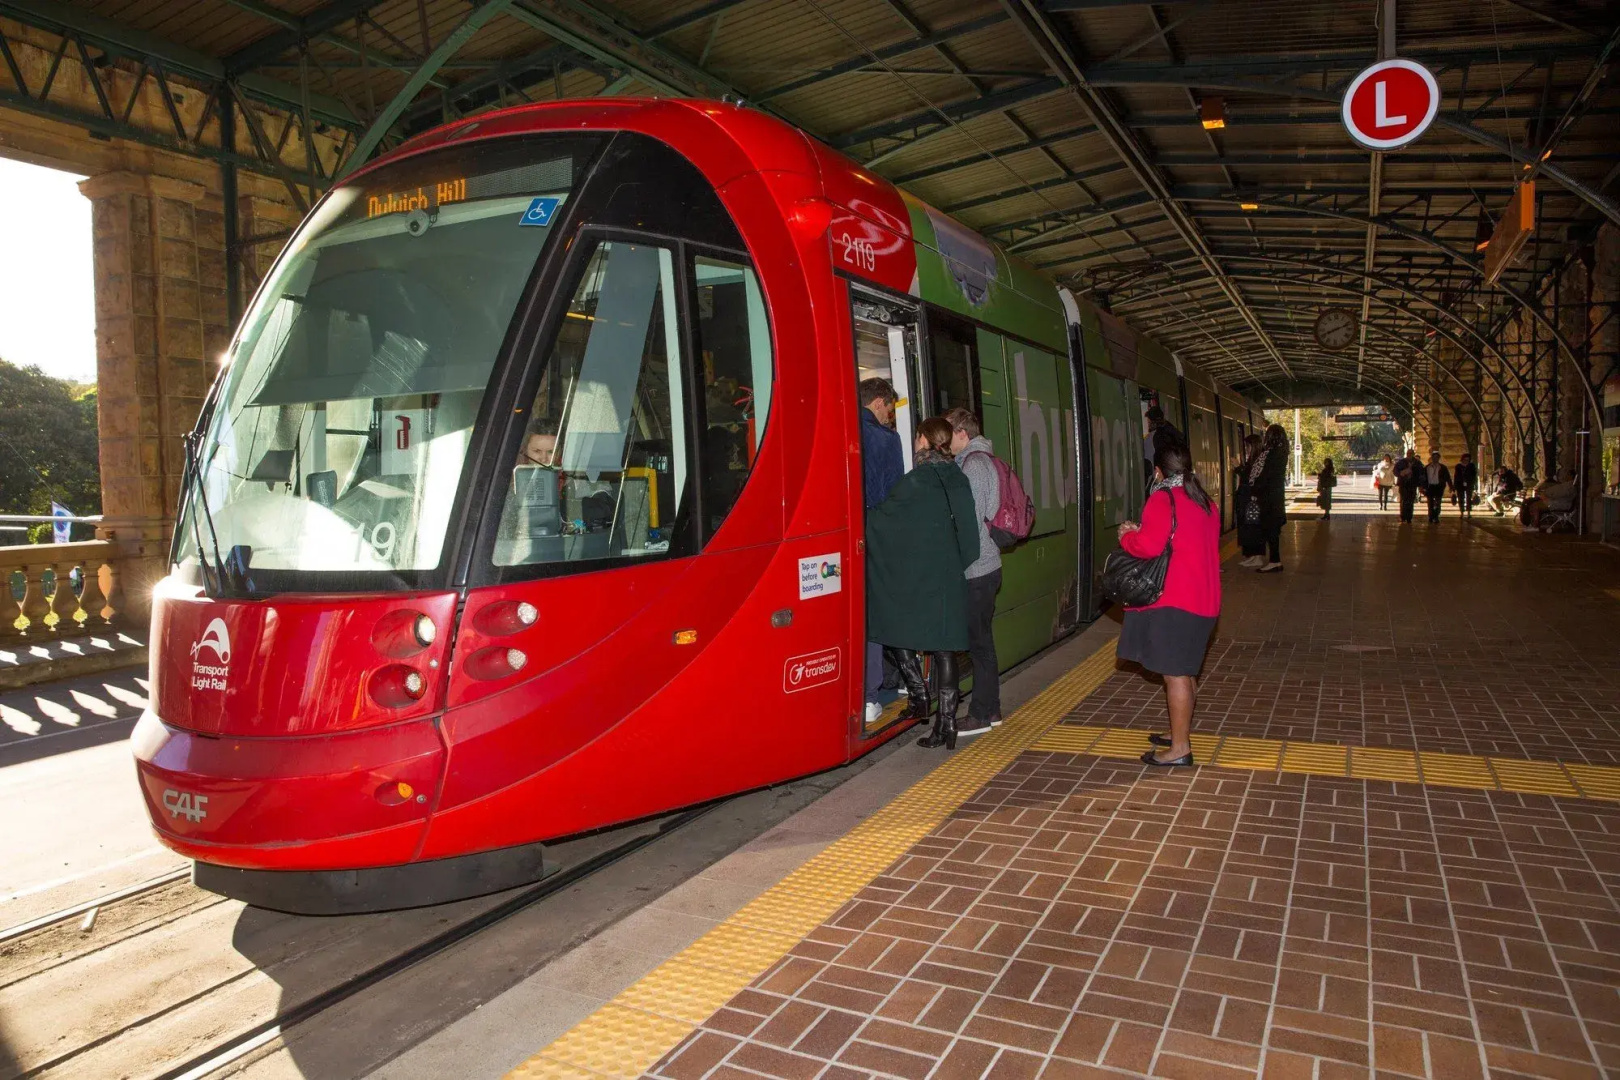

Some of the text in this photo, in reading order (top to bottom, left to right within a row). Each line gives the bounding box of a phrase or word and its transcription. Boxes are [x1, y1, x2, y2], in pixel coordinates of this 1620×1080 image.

[1375, 80, 1407, 128] L
[368, 178, 466, 218] Dulwich Hill
[842, 232, 875, 272] 2119
[351, 521, 396, 563] 19
[801, 562, 818, 572] Tap on
[801, 572, 818, 582] before
[802, 582, 824, 593] boarding
[193, 661, 229, 678] Transport
[805, 662, 836, 678] transdev
[192, 675, 227, 691] Light Rail
[162, 789, 208, 823] CAF
